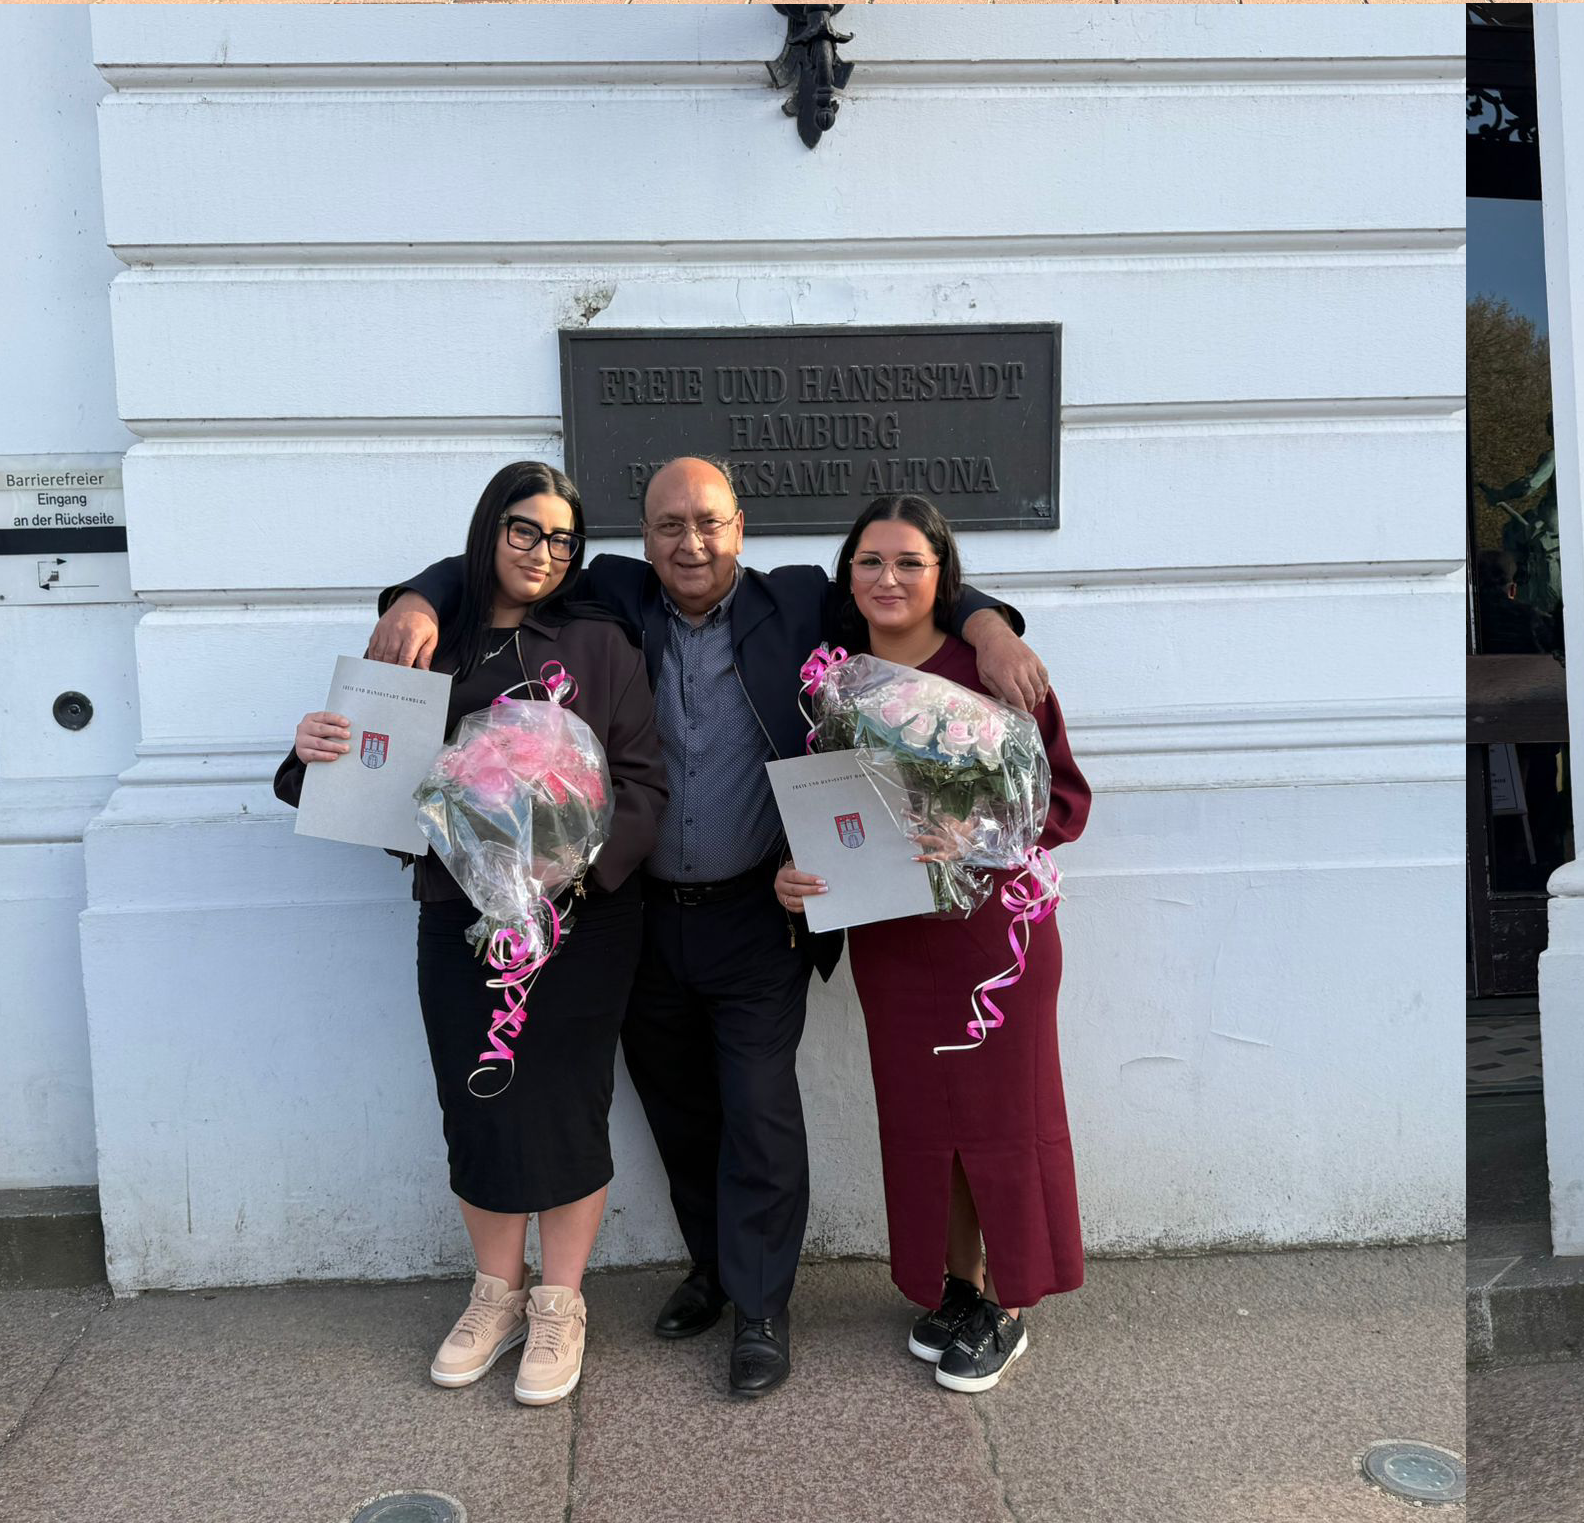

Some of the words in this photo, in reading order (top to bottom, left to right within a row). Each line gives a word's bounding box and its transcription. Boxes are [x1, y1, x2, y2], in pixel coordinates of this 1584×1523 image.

[600, 366, 703, 405] FREIE
[715, 365, 788, 404] UND
[798, 362, 1025, 403] HANSESTADT
[729, 412, 900, 451] HAMBURG
[6, 473, 104, 487] Barrierefreier
[628, 459, 852, 499] BKSAMT
[861, 456, 1000, 496] ALTONA
[37, 492, 87, 507] Eingang
[13, 516, 29, 527] an
[32, 514, 52, 526] der
[55, 512, 115, 526] Rückseite
